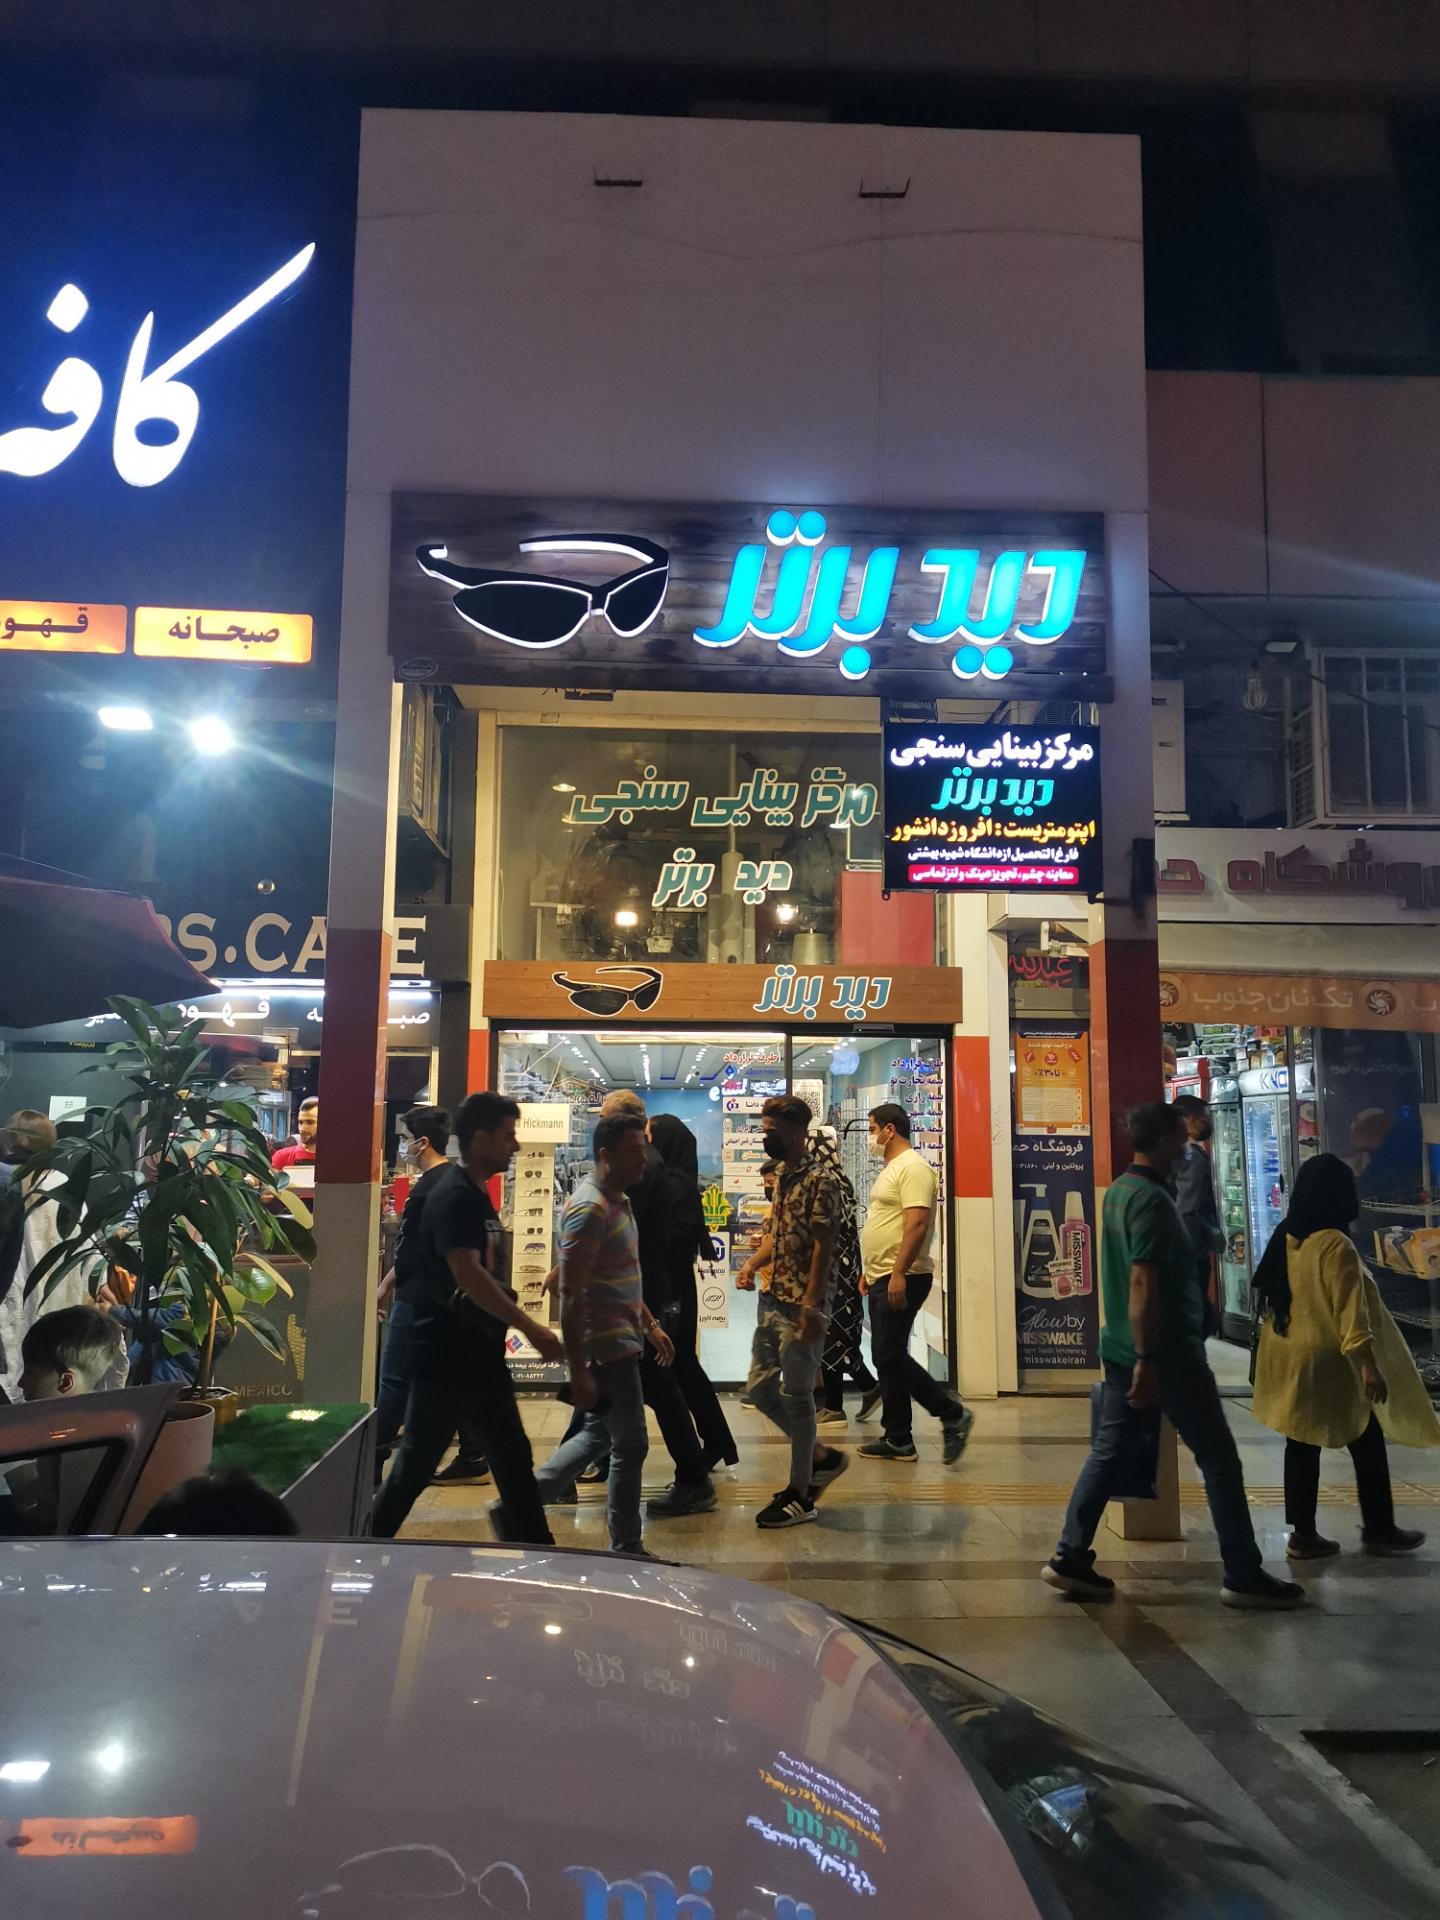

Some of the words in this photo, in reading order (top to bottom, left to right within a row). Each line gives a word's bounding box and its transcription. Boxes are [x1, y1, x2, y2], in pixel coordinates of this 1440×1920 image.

[692, 509, 900, 680] برتر
[0, 606, 90, 641] قهو
[167, 614, 281, 650] صبحانه
[908, 547, 1089, 680] دید
[890, 734, 966, 767] سنجی
[966, 731, 1041, 768] بینایی
[1040, 732, 1094, 769] مرکز
[568, 765, 690, 826] سنجی
[690, 768, 799, 828] بینایی
[800, 766, 878, 829] مرکز
[930, 766, 998, 816] برتر
[999, 778, 1055, 816] دید
[890, 817, 948, 842] دانشور
[946, 816, 993, 842] افروز
[908, 847, 940, 861] بهشتی
[940, 847, 965, 859] شهید
[652, 846, 716, 908] برتر
[733, 859, 794, 905] دید
[753, 964, 824, 1021] برتر
[830, 974, 892, 1021] دید
[1032, 1138, 1084, 1157] فروشگاه
[1066, 1315, 1086, 1331] by
